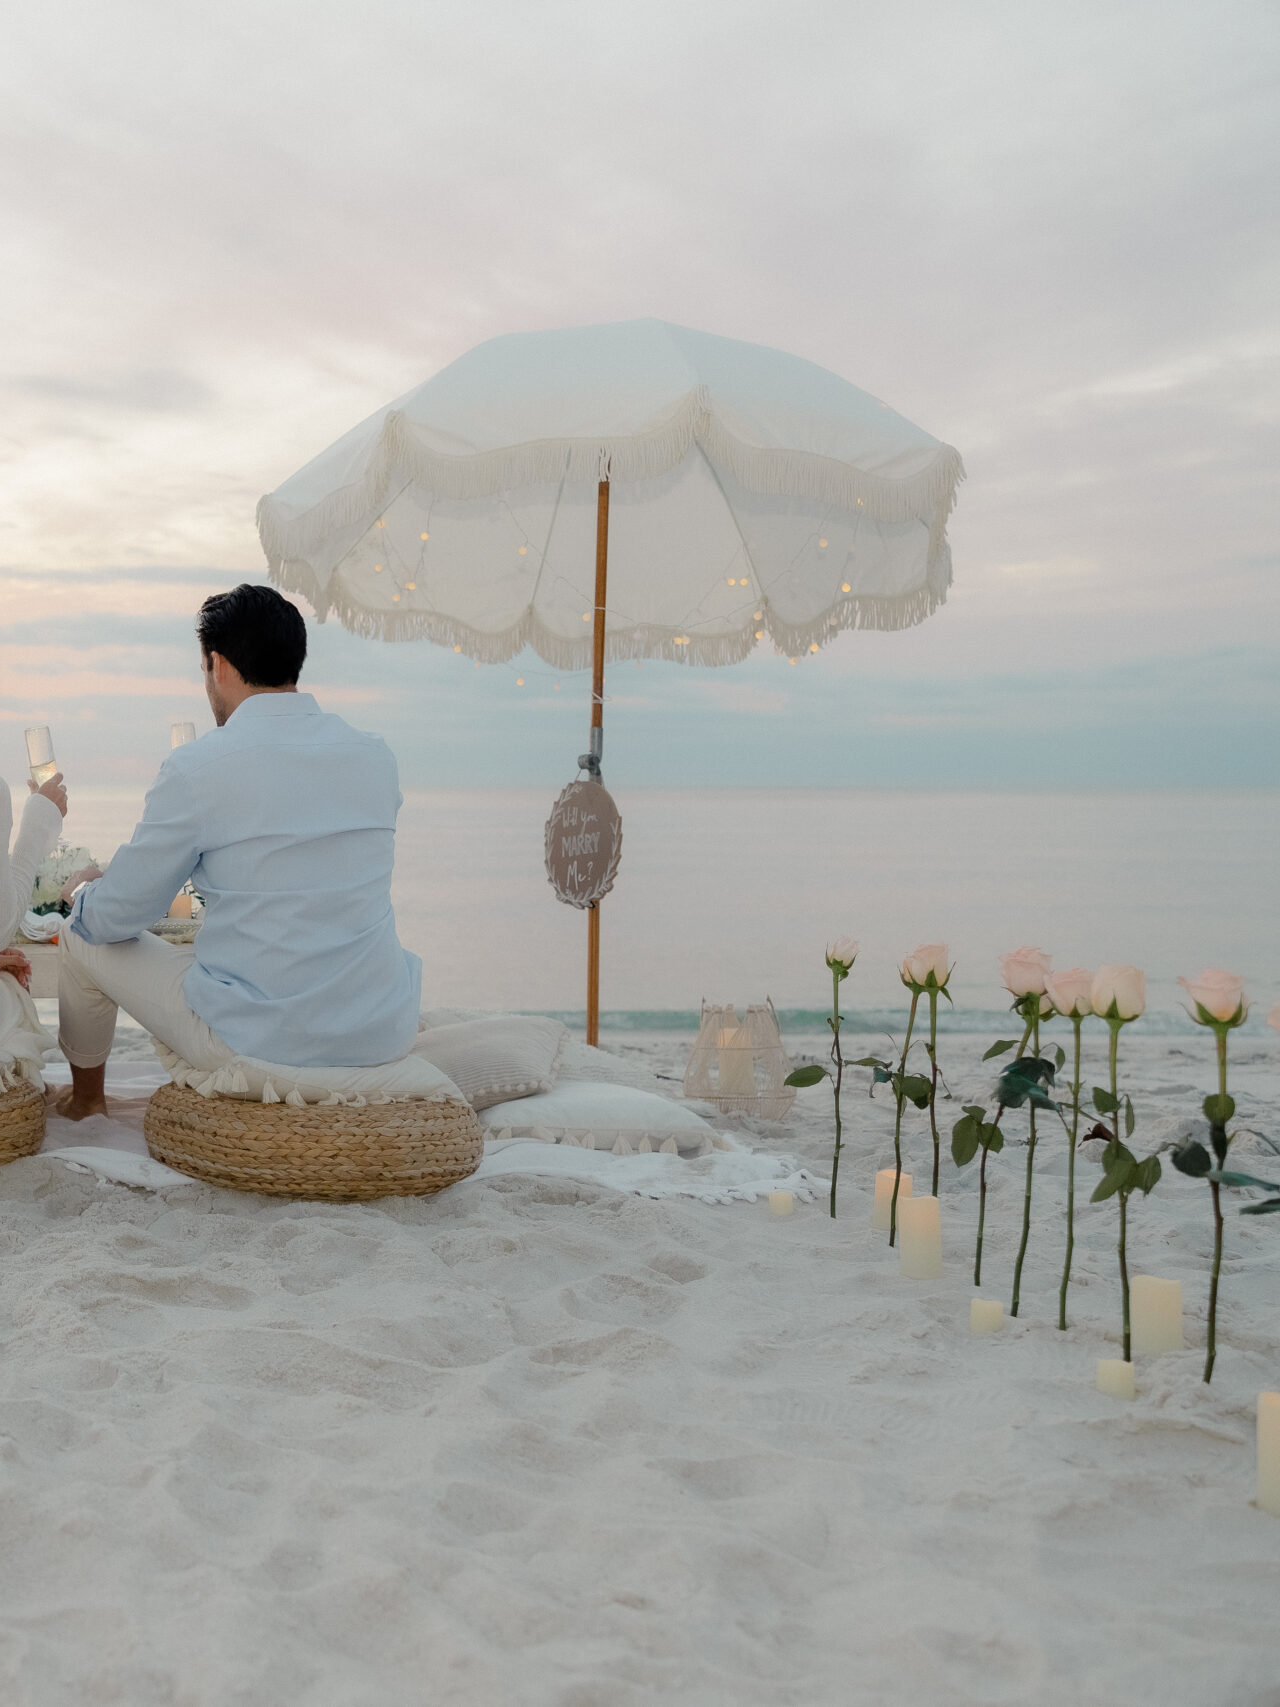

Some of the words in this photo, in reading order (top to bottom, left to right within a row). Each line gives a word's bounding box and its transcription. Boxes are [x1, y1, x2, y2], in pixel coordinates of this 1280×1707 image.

[562, 807, 578, 828] Will
[580, 811, 598, 835] you
[561, 832, 600, 858] MARRY
[566, 860, 593, 891] Me?
